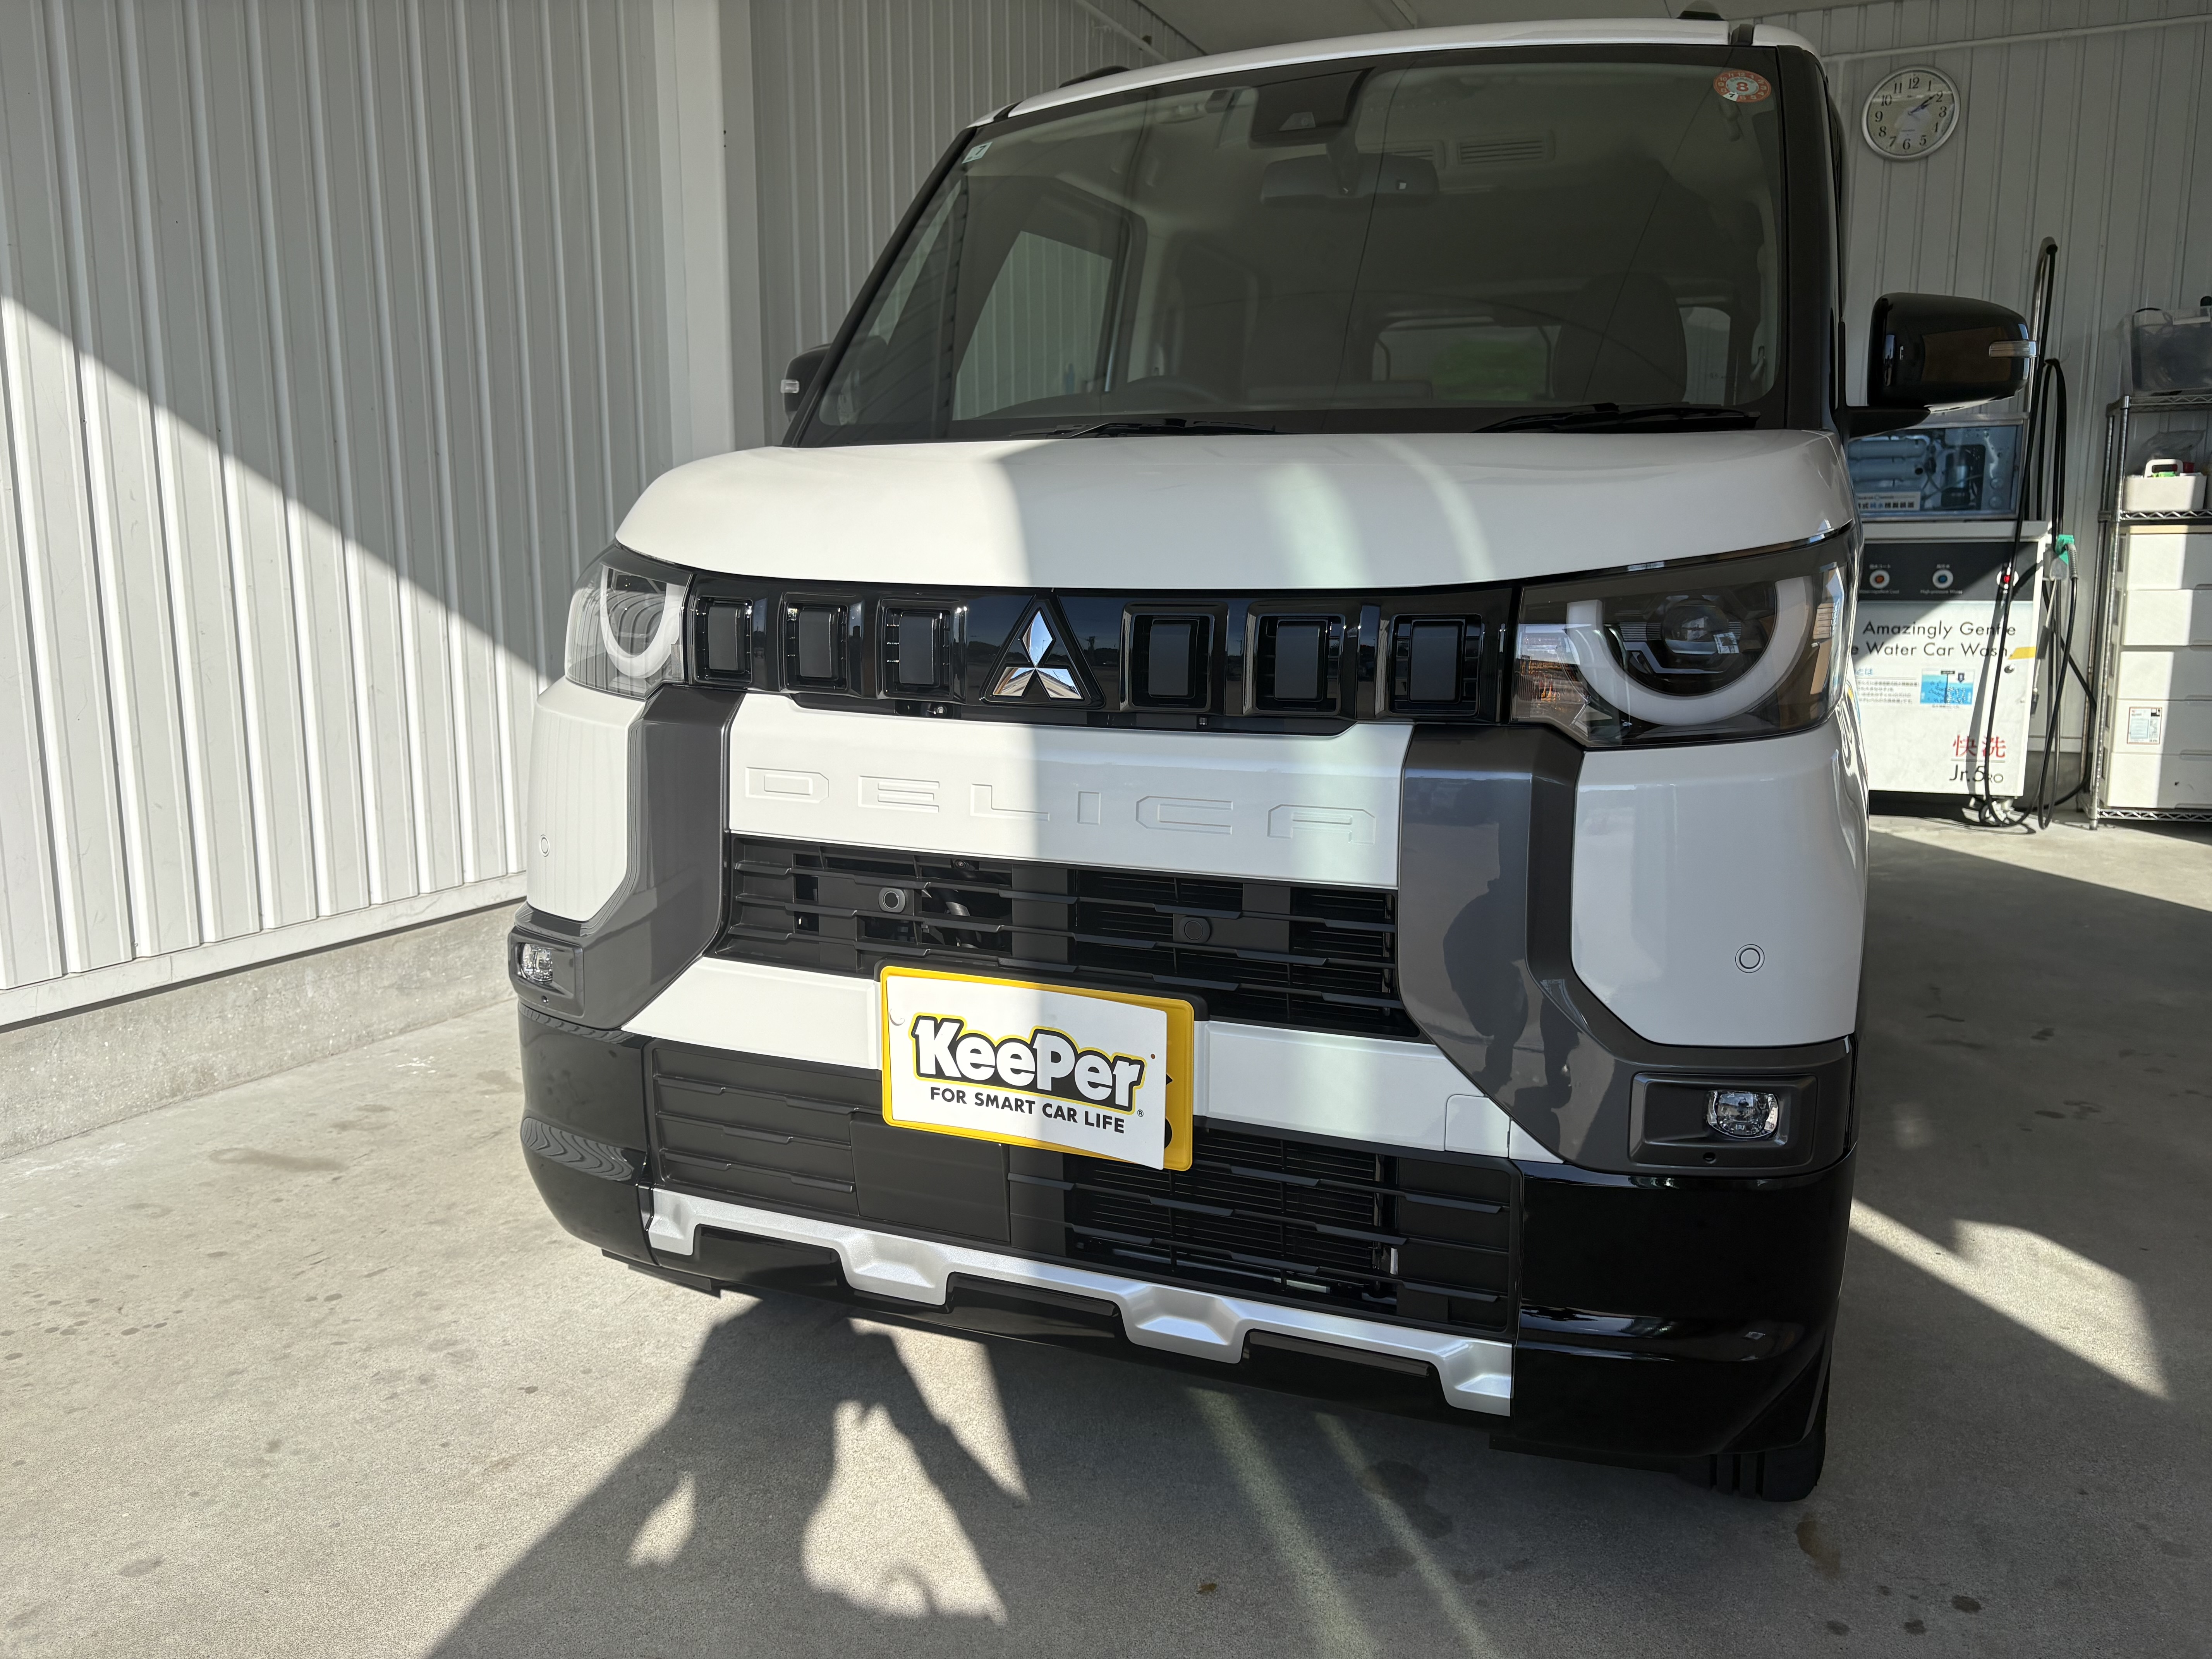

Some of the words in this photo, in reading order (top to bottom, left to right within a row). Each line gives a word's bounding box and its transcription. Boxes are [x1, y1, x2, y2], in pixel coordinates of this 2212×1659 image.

[1736, 82, 1749, 91] 8
[1894, 82, 1902, 94] 11
[1909, 77, 1920, 89] 12
[1928, 80, 1932, 91] 1
[1881, 94, 1892, 106] 10
[1936, 91, 1943, 102] 2
[1875, 111, 1883, 122] 9
[1939, 106, 1947, 118] 3
[1879, 126, 1887, 137] 8
[1889, 136, 1897, 147] 7
[1903, 138, 1911, 150] 6
[1919, 134, 1927, 146] 5
[975, 144, 987, 155] 7
[1863, 620, 1953, 639] Amazingly
[1960, 621, 2016, 635] Gente
[1866, 641, 1917, 656] Water
[1924, 642, 1954, 656] Car
[1953, 734, 2006, 758] 快洗
[744, 766, 1377, 846] DELICA
[912, 1016, 1144, 1111] KeePer
[930, 1087, 967, 1104] FOR
[974, 1092, 1036, 1115] SMART
[1042, 1103, 1078, 1125] CAR
[1084, 1110, 1125, 1134] LIFE
